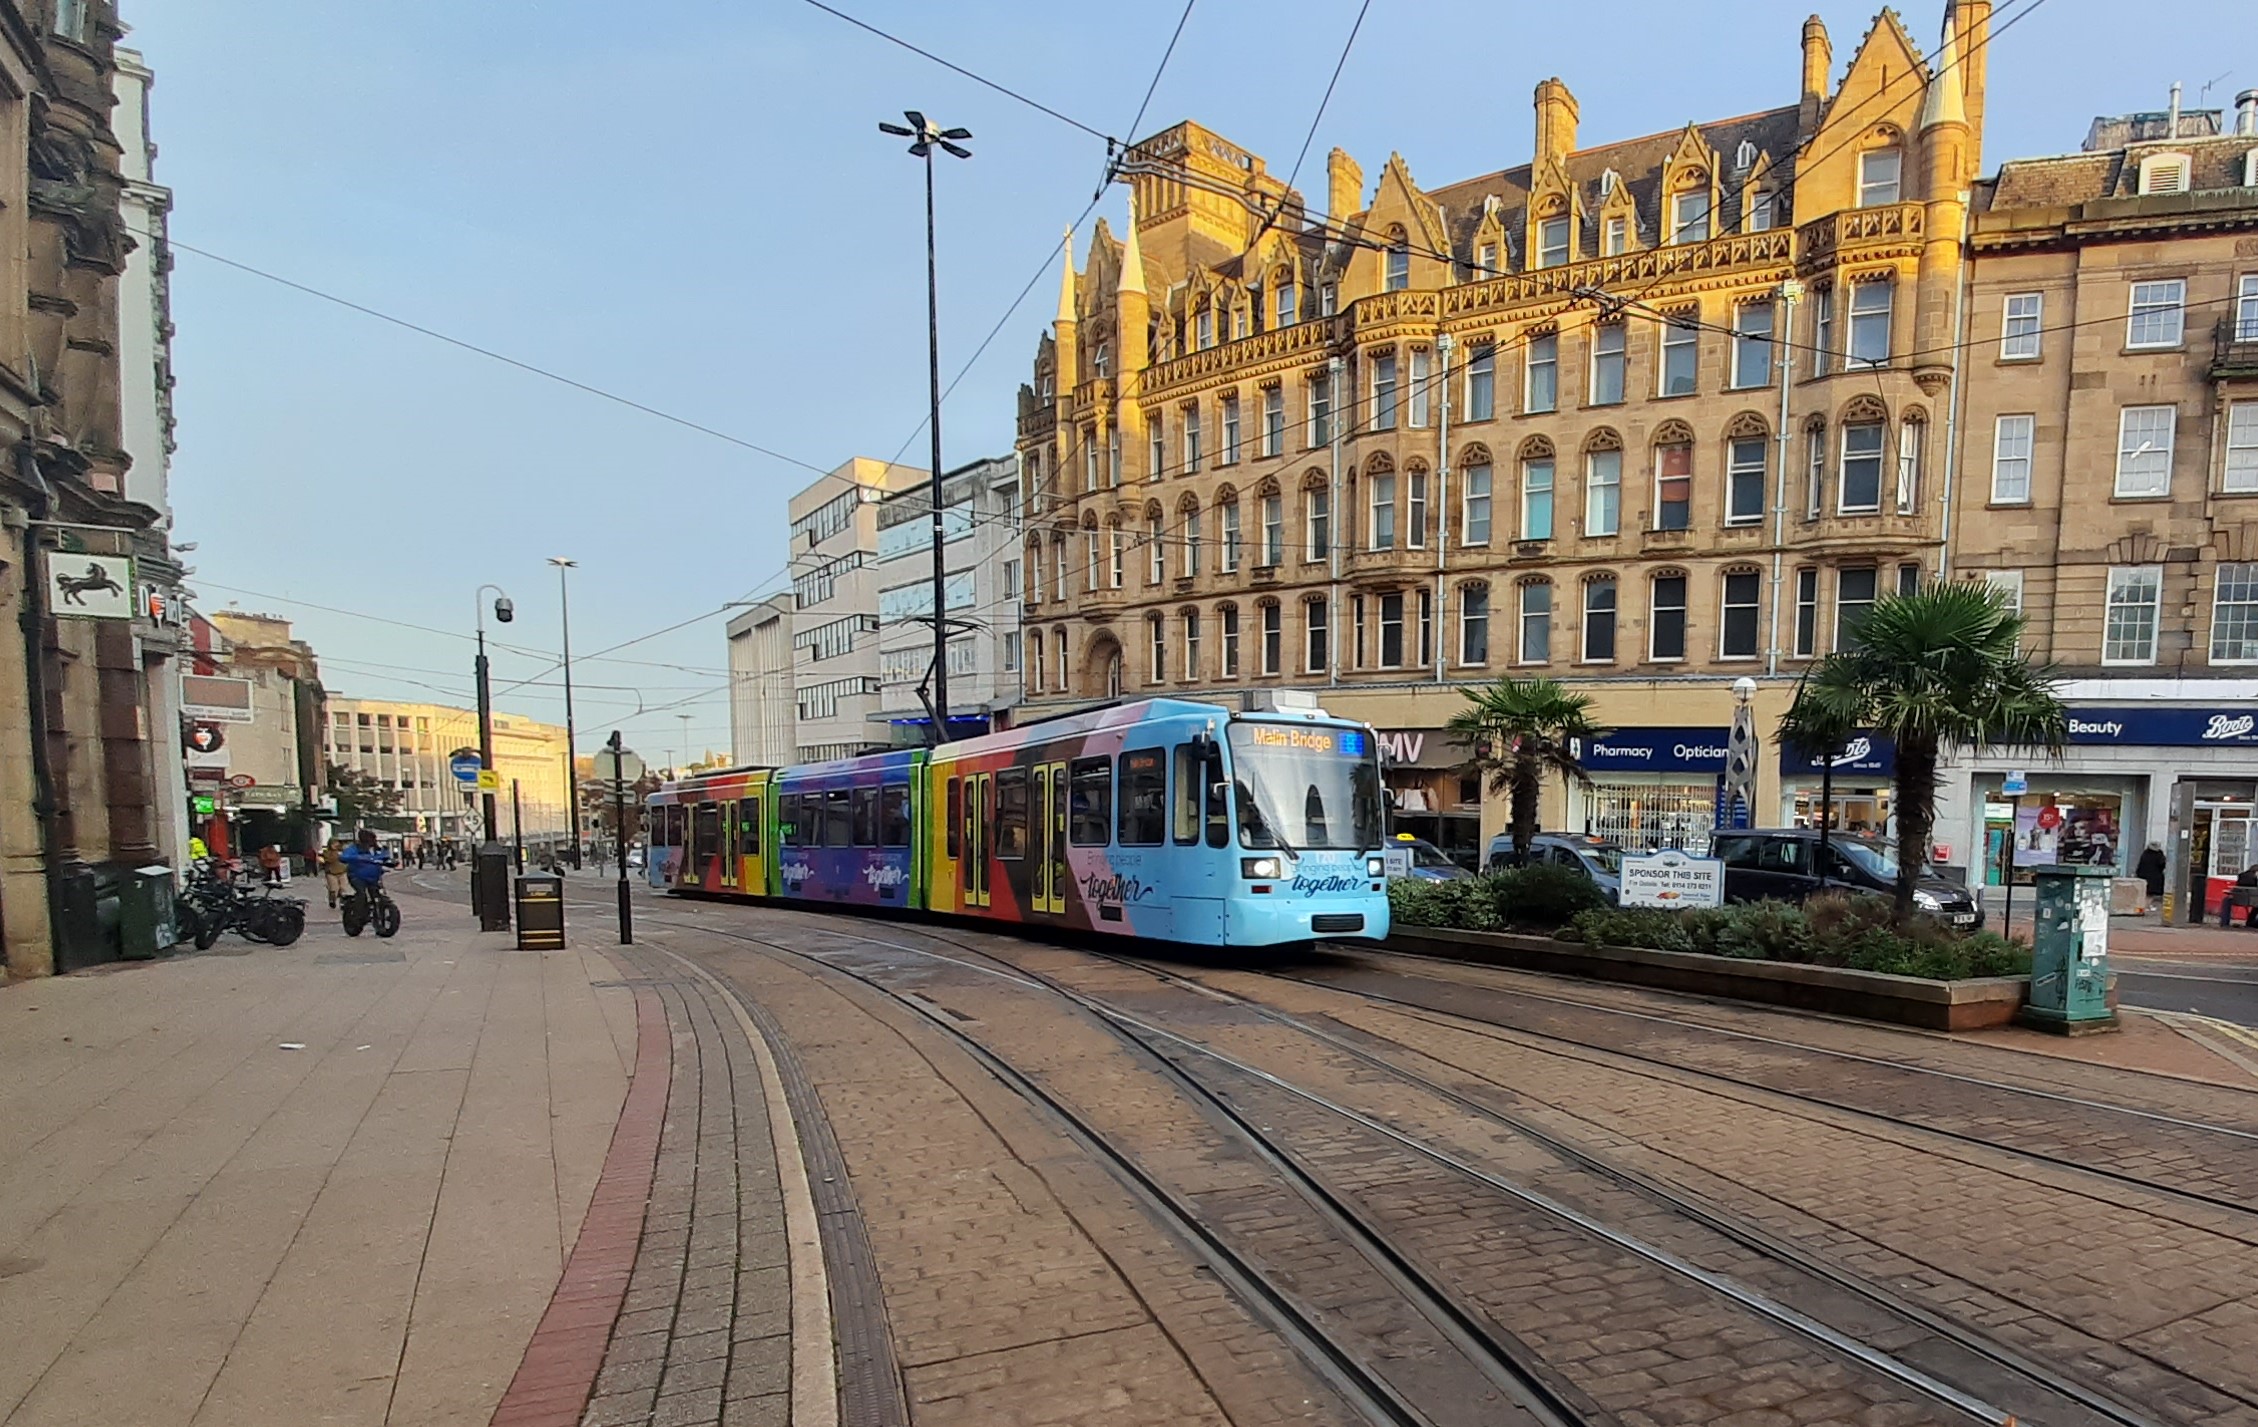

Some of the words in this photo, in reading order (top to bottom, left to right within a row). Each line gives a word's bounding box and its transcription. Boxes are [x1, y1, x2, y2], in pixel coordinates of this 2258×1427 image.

[2069, 719, 2122, 737] Beauty
[2202, 715, 2254, 739] Boots
[1253, 727, 1287, 746] Malin
[1290, 729, 1332, 752] Bridge
[1593, 743, 1653, 760] Pharmacy
[1292, 874, 1370, 898] together
[1629, 868, 1670, 879] SPONSOR
[1672, 870, 1692, 880] THIS
[1693, 871, 1712, 881] SITE
[1080, 871, 1153, 911] together
